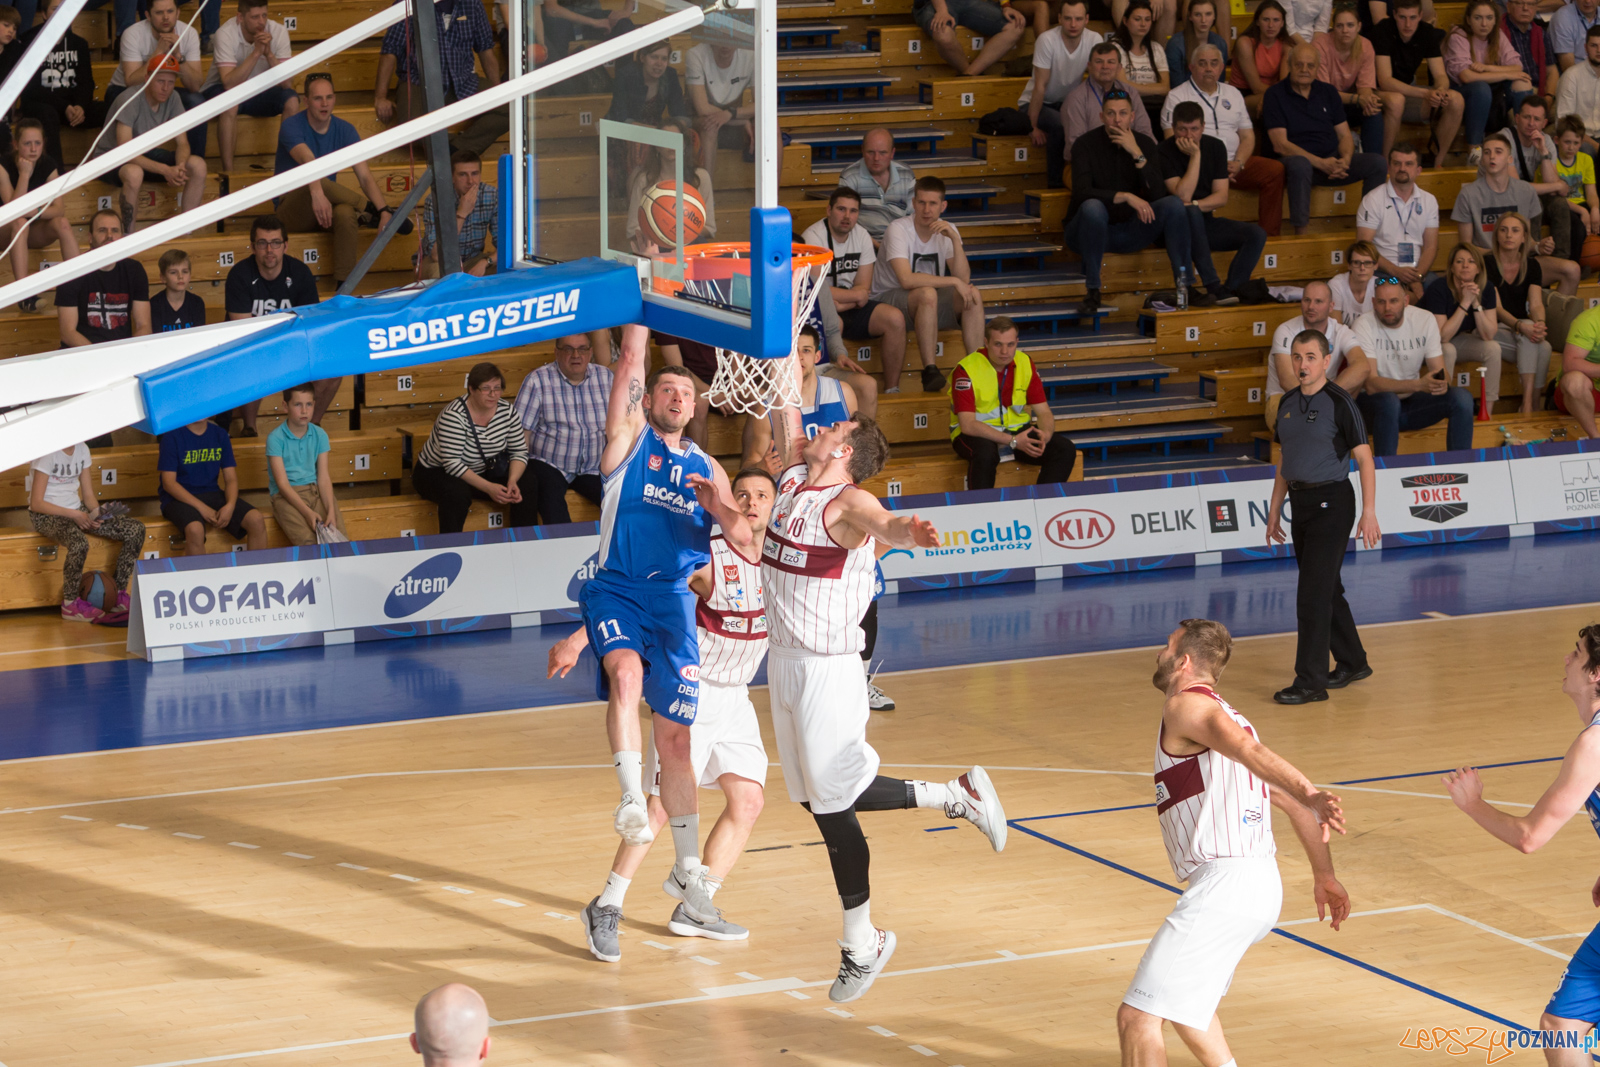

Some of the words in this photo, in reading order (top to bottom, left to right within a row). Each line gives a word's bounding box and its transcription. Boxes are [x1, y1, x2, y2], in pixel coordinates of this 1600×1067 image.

[285, 19, 296, 29] 14
[911, 41, 918, 51] 8
[975, 38, 981, 48] 7
[964, 95, 970, 104] 8
[1018, 149, 1024, 159] 8
[1336, 192, 1343, 201] 4
[101, 198, 108, 209] 2
[671, 202, 702, 230] olten
[220, 254, 233, 264] 15
[304, 250, 317, 261] 16
[1268, 256, 1274, 266] 6
[1334, 252, 1340, 262] 5
[252, 299, 292, 316] USA
[367, 313, 464, 351] SPORT
[466, 288, 580, 335] SYSTEM
[1189, 328, 1195, 338] 8
[1256, 323, 1263, 333] 7
[858, 348, 870, 359] 10
[399, 377, 411, 388] 16
[1460, 374, 1467, 384] 5
[1251, 390, 1257, 400] 8
[914, 415, 927, 426] 10
[182, 448, 222, 464] ADIDAS
[360, 456, 365, 467] 1
[105, 471, 112, 482] 4
[1413, 474, 1456, 484] SECURITY
[889, 483, 901, 494] 11
[1413, 487, 1462, 505] JOKER
[490, 514, 502, 525] 16
[1131, 509, 1197, 535] DELIK
[938, 520, 1032, 548] unclub
[1056, 517, 1105, 541] KIA
[925, 547, 966, 557] biuro
[971, 542, 1032, 555] podróży
[394, 576, 448, 596] atrem
[153, 577, 316, 619] BIOFARM
[169, 620, 204, 631] POLSKI
[209, 614, 267, 627] PRODUCENT
[272, 610, 305, 622] LEKÓW
[598, 618, 621, 639] 11
